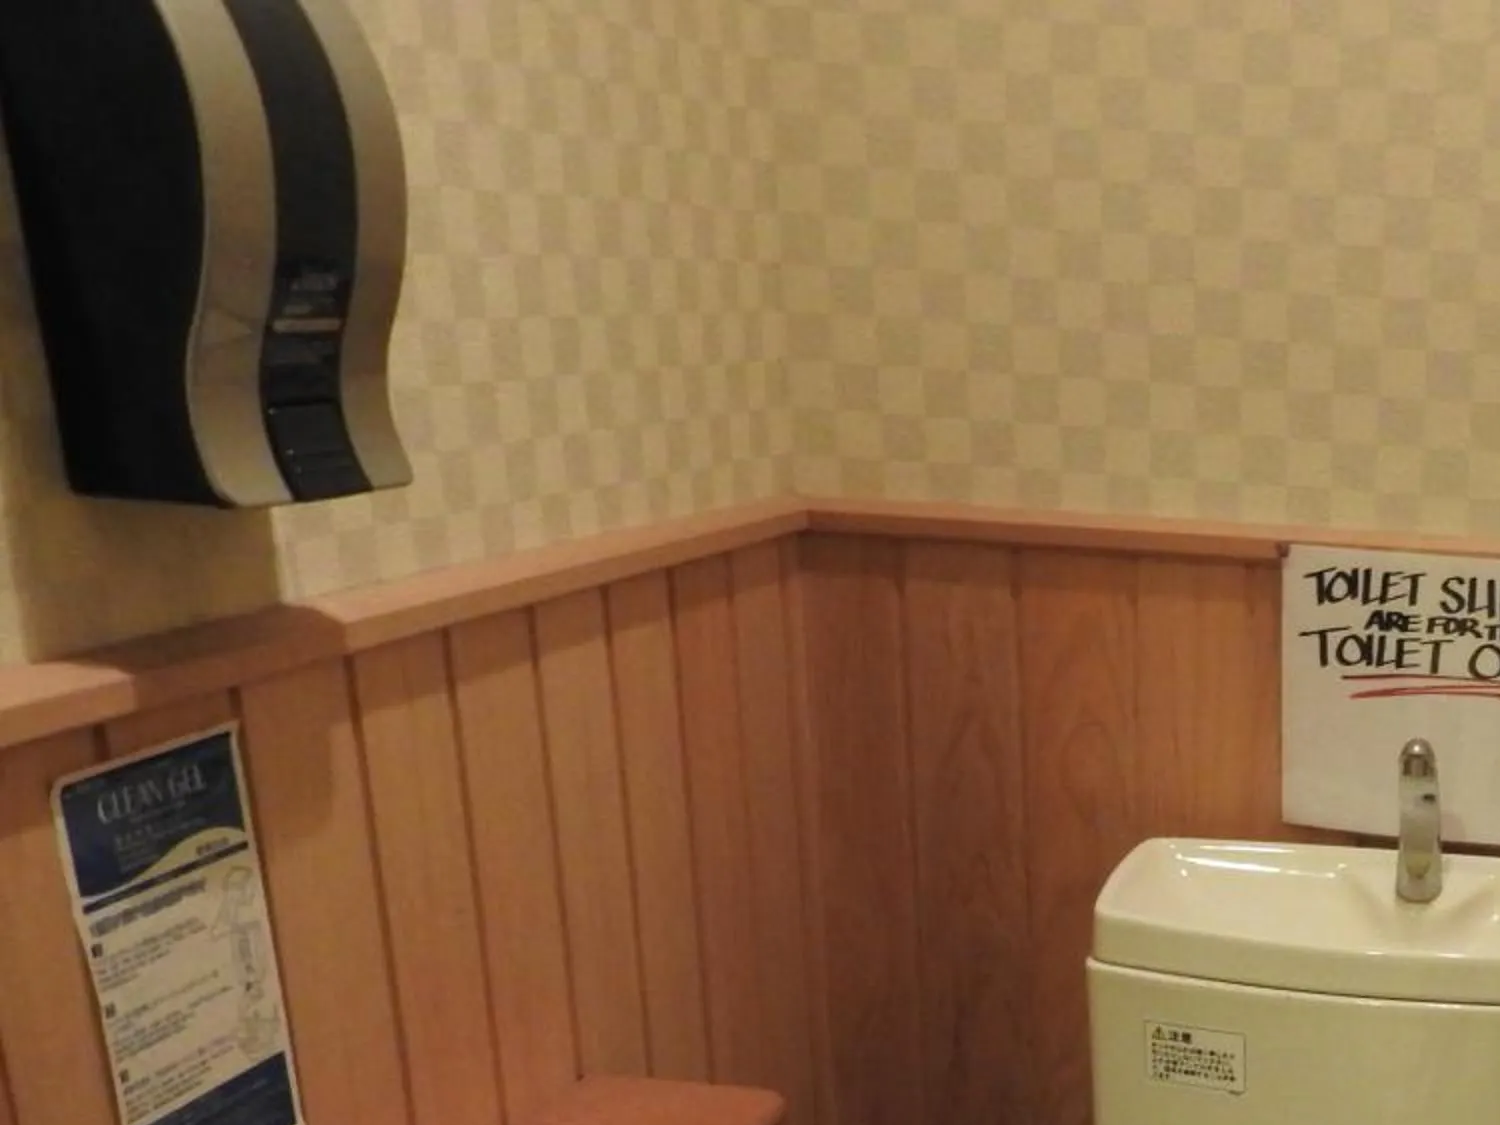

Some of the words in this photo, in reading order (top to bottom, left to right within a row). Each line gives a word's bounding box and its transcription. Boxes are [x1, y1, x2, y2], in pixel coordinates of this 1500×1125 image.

[1303, 567, 1426, 606] TOILET
[1364, 609, 1423, 633] ARE
[1426, 616, 1482, 639] FOR
[1299, 626, 1454, 675] TOILET
[97, 779, 164, 824] CLEAN
